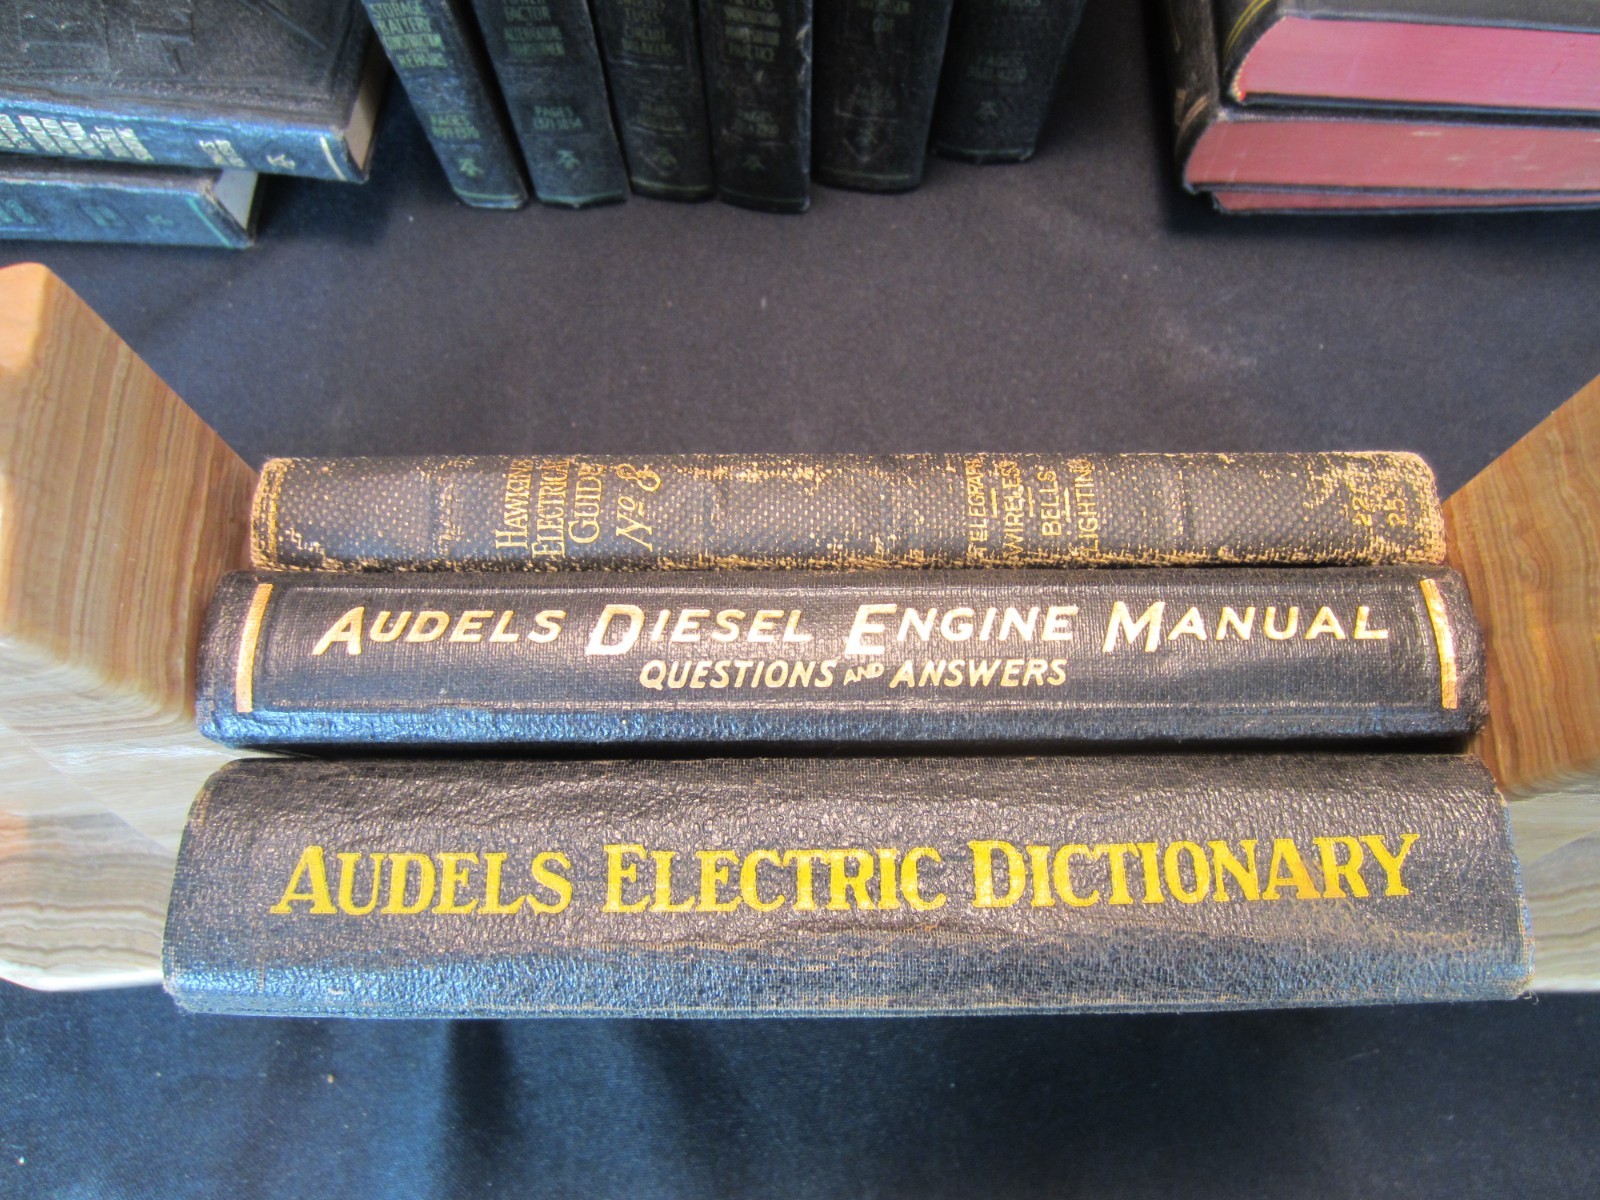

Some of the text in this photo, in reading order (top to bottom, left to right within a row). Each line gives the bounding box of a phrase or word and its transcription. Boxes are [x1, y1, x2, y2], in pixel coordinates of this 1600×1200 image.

[370, 1, 428, 20] STORAGE
[532, 459, 570, 558] ELECTRICAL
[568, 463, 605, 544] GUIDE
[1000, 460, 1026, 555] WIRELESS
[1037, 469, 1063, 536] BELLS
[311, 600, 1390, 656] AUDELS DIESEL ENGINE MANUAL
[638, 657, 1069, 690] QUESTIONS AND ANSWERS
[270, 832, 1422, 916] AUDELS ELECTRIC DICTIONARY
